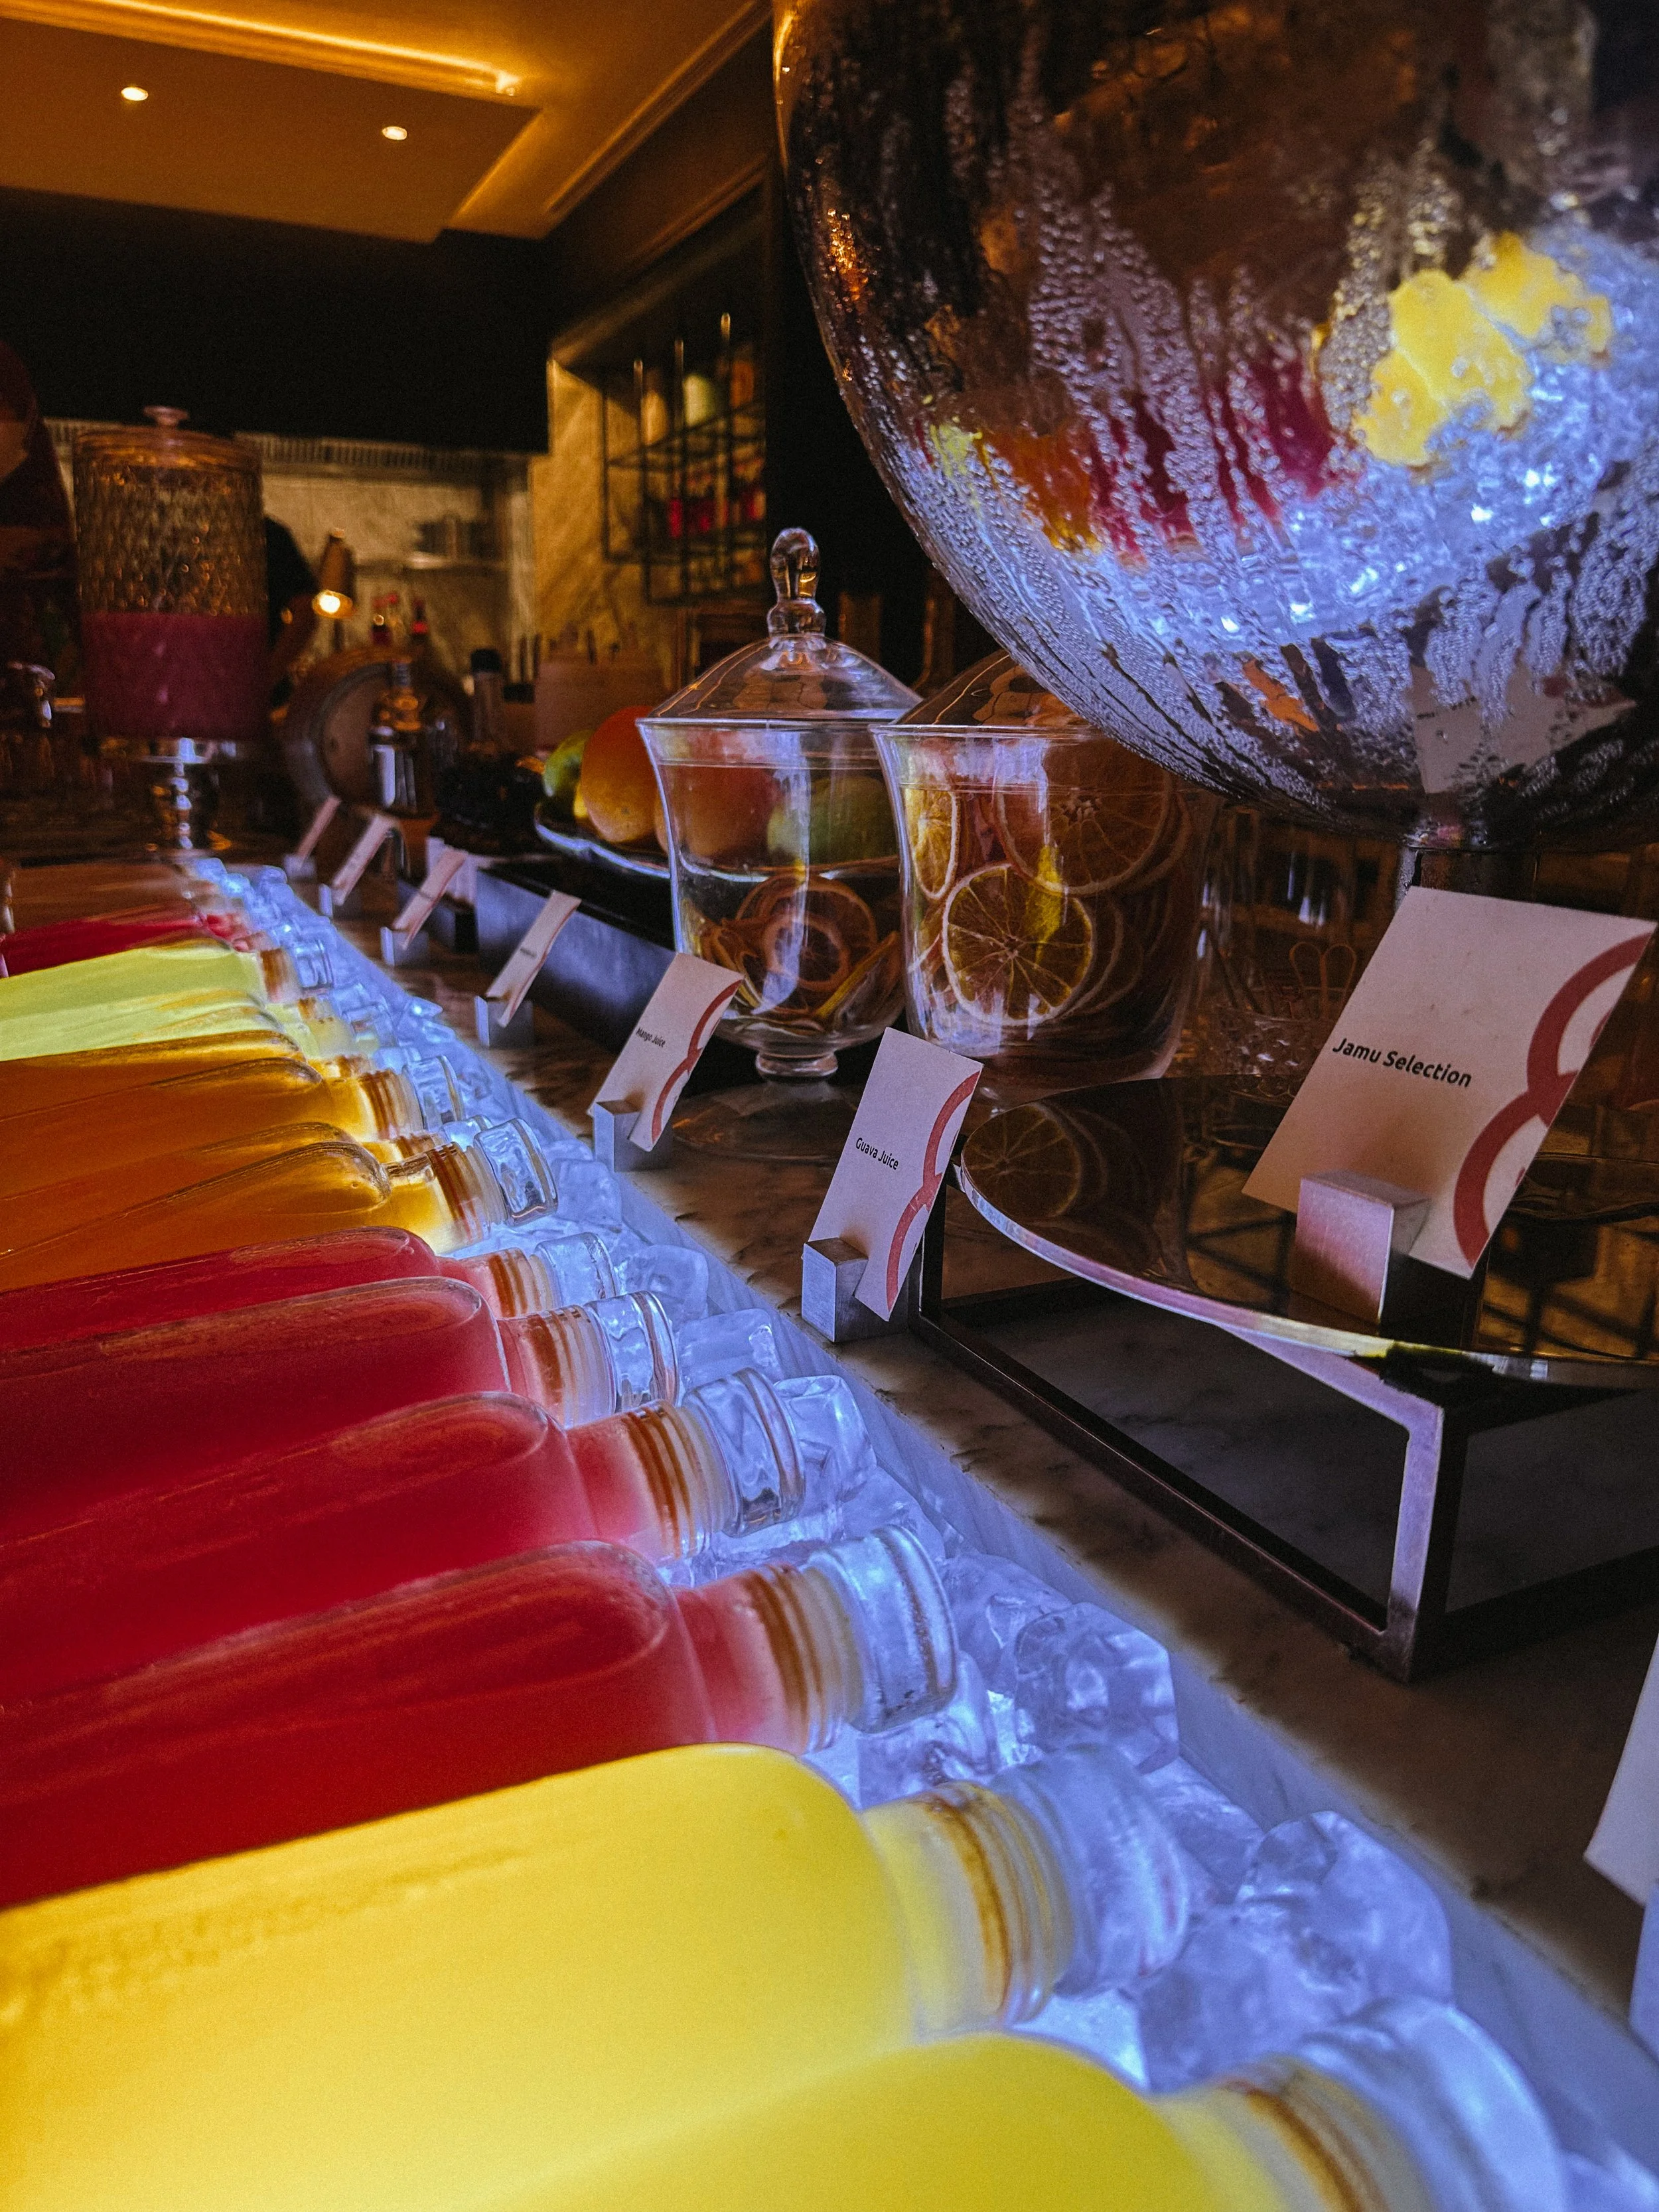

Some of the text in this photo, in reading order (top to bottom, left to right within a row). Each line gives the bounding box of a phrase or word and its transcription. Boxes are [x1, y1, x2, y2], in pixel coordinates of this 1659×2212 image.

[652, 1035, 666, 1047] Juice
[1333, 1038, 1471, 1087] Jamu Selection
[855, 1138, 899, 1170] Guava Juice
